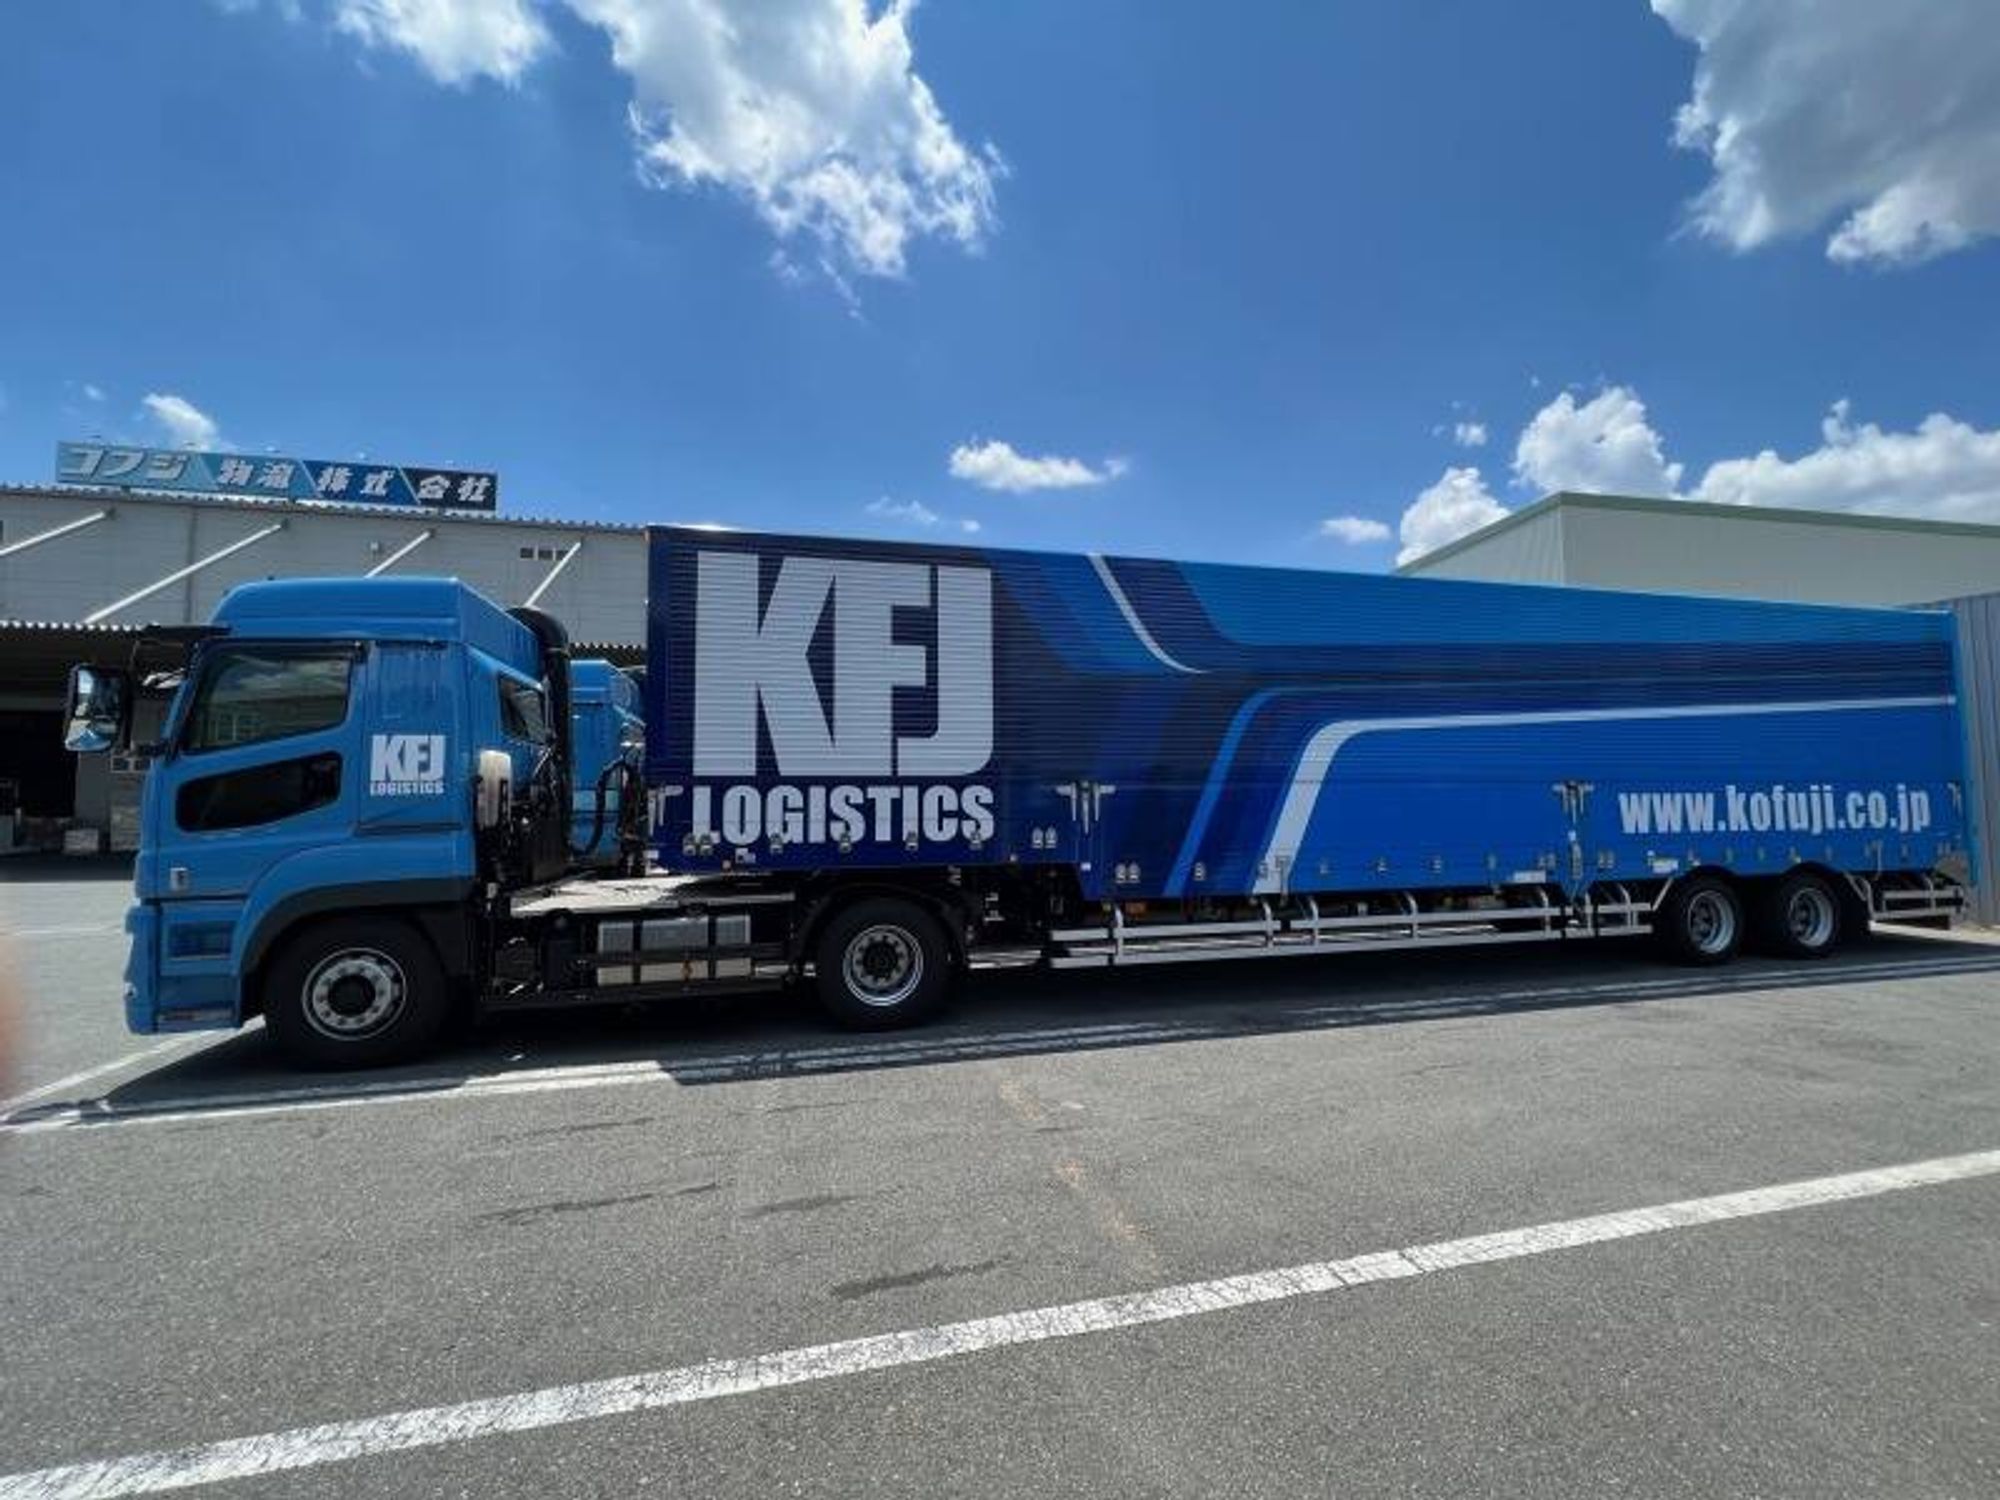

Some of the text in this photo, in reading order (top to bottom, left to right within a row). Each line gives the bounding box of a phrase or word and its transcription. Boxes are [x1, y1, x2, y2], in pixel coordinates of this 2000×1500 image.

[693, 550, 994, 776] KFJ
[370, 734, 446, 781] KFJ
[369, 782, 445, 797] LOGISTICS
[692, 784, 995, 846] LOGISTICS
[1618, 784, 1932, 835] www.kofuji.co.jp
